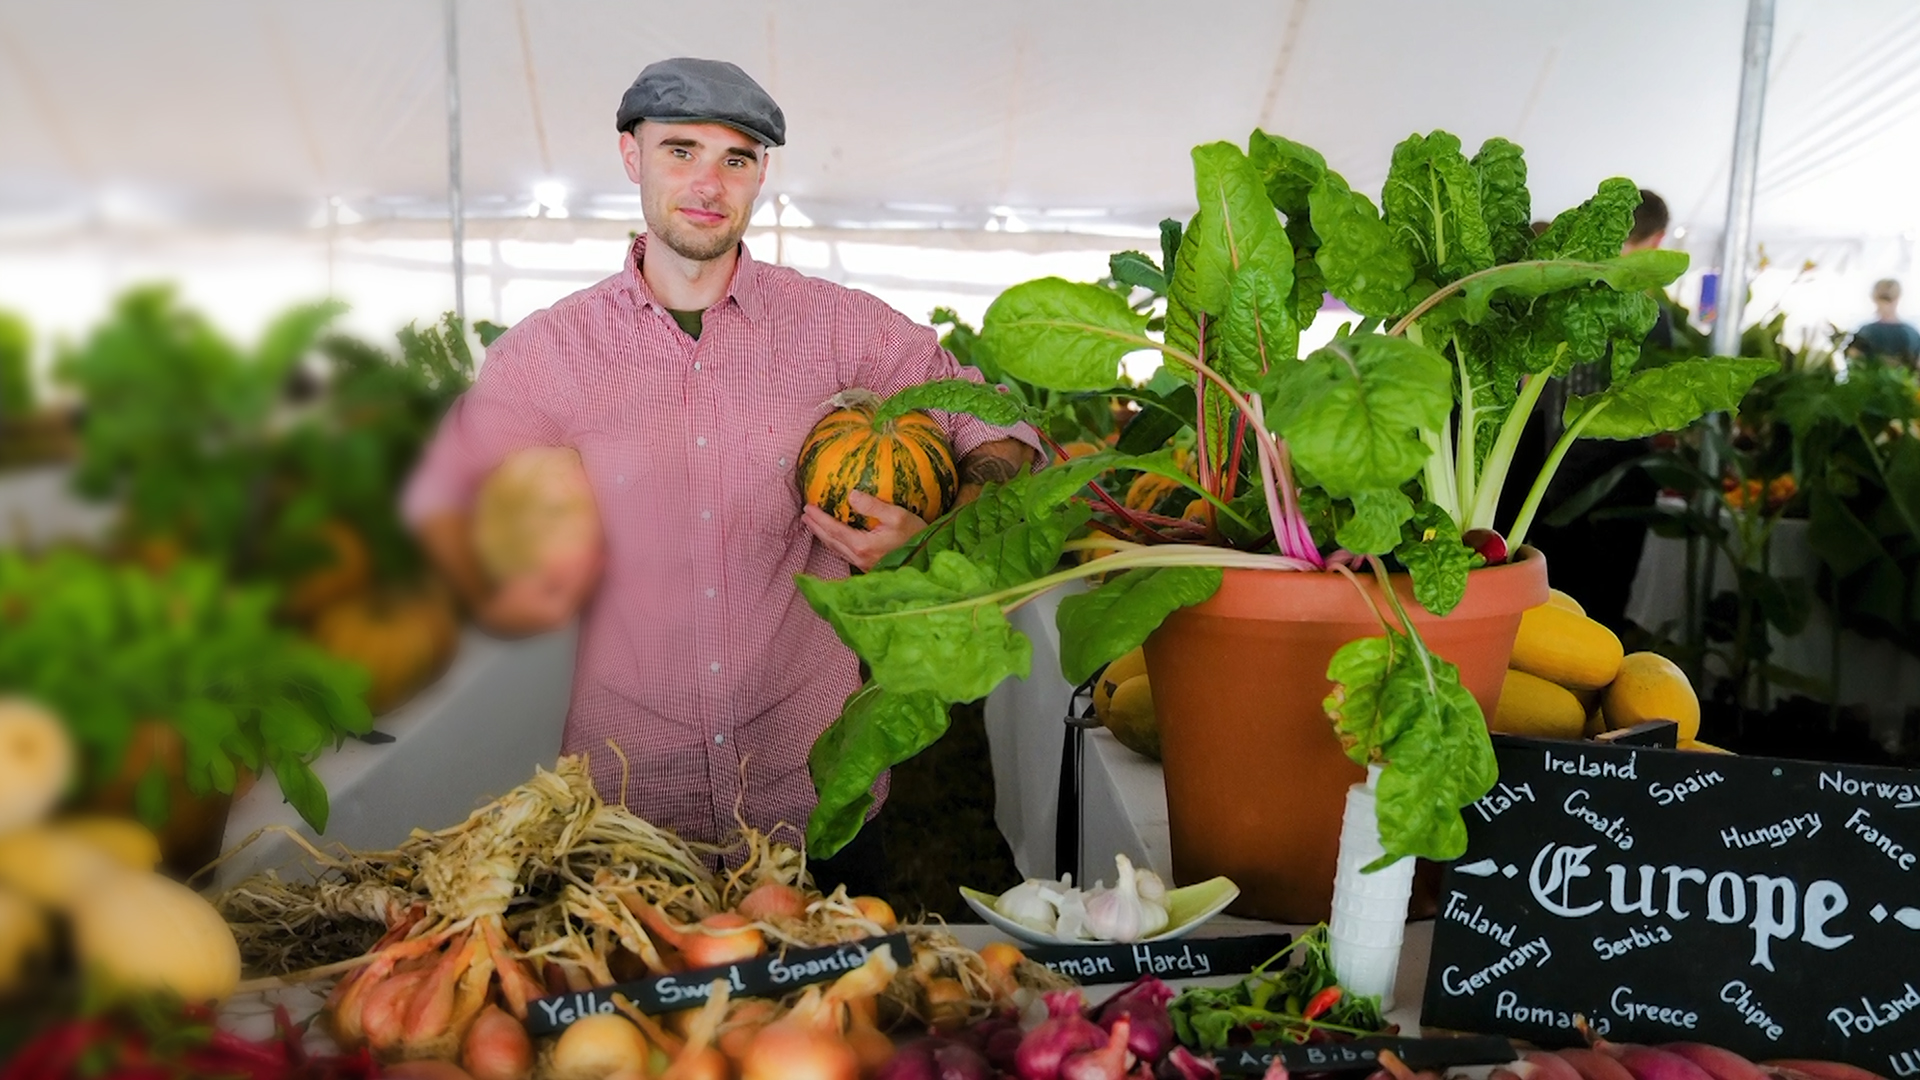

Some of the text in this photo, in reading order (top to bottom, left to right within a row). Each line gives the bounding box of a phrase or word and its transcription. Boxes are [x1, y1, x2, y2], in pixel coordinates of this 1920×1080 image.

[1473, 782, 1536, 823] Italy
[1649, 769, 1725, 806] Spain
[1563, 789, 1634, 850] Croatia
[1720, 812, 1823, 849] Hungary
[1844, 807, 1917, 871] France
[1528, 841, 1854, 973] Europe
[1132, 944, 1211, 976] Hardy
[1593, 924, 1673, 960] Serbia
[1442, 936, 1552, 996] Germany
[538, 991, 640, 1027] Yello
[1611, 986, 1698, 1029] Greece
[1720, 980, 1784, 1041] Chipre
[1308, 1045, 1405, 1064] Bibei
